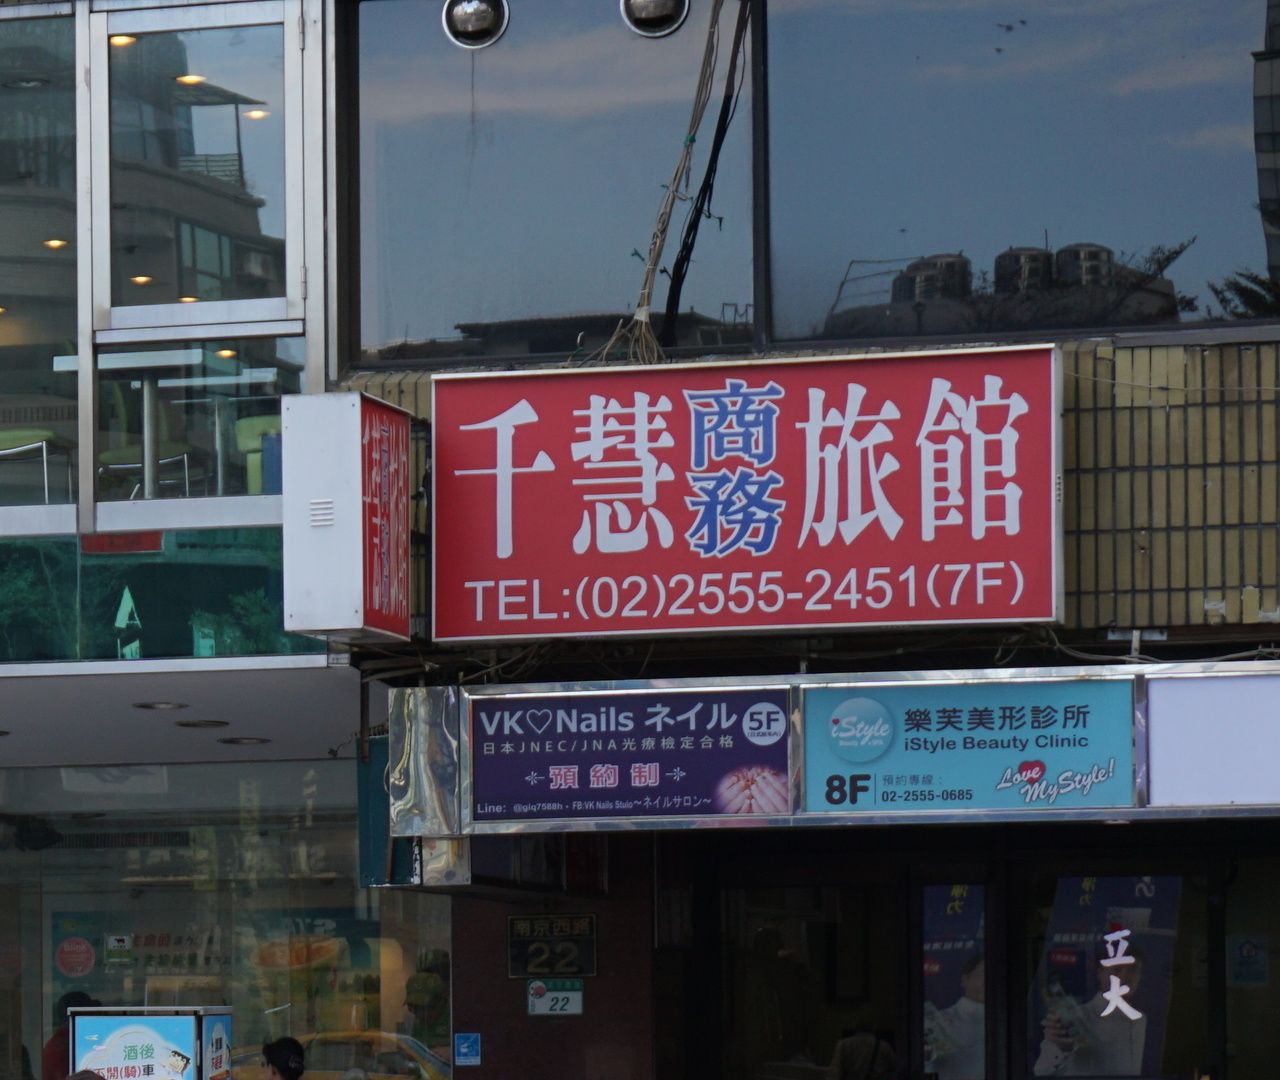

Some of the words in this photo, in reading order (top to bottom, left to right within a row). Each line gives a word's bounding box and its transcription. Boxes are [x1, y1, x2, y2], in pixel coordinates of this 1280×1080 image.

[464, 559, 1024, 624] TEL:(02)2555-2451(7F)
[644, 702, 738, 733] ネイル
[748, 710, 781, 732] 5F
[831, 715, 891, 746] iStyle
[903, 704, 1091, 732] 樂芙美形診所
[904, 736, 957, 754] iStyle
[963, 734, 1028, 753] Beauty
[1035, 733, 1089, 749] Clinic
[549, 762, 660, 790] 預約制
[825, 774, 872, 806] 8F
[995, 762, 1044, 792] Love
[477, 802, 507, 814] Line:
[881, 788, 973, 803] 02-2555-0685
[512, 919, 591, 936] 南京西路
[527, 941, 581, 974] 22
[1099, 928, 1143, 1021] 立大
[549, 996, 571, 1012] 22
[123, 1043, 155, 1061] 酒後
